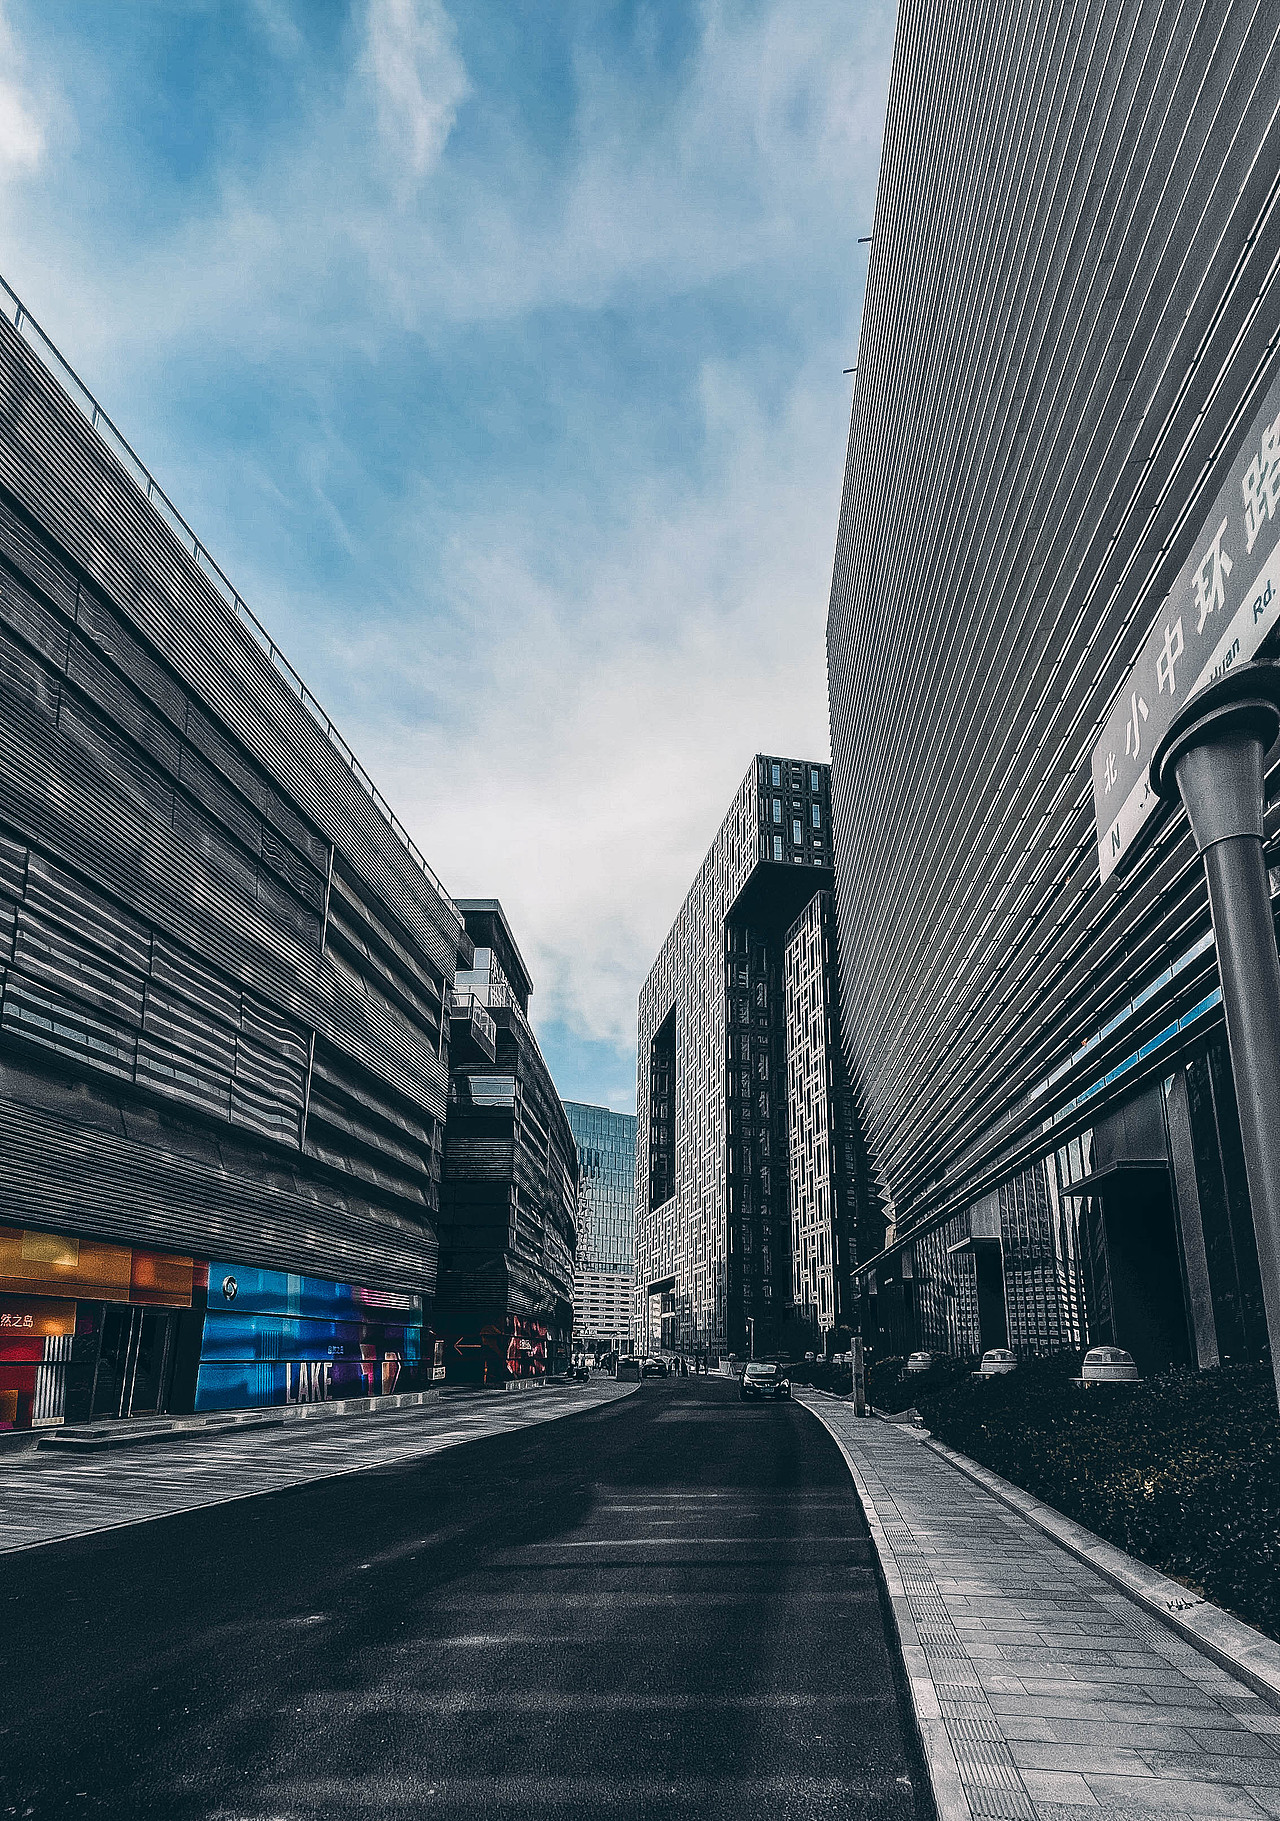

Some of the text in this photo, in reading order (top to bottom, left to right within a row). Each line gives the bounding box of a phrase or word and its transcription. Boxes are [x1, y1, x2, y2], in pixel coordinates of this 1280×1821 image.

[1253, 579, 1276, 624] Rd.
[0, 1313, 34, 1328] 然之岛
[286, 1362, 333, 1404] LAKE
